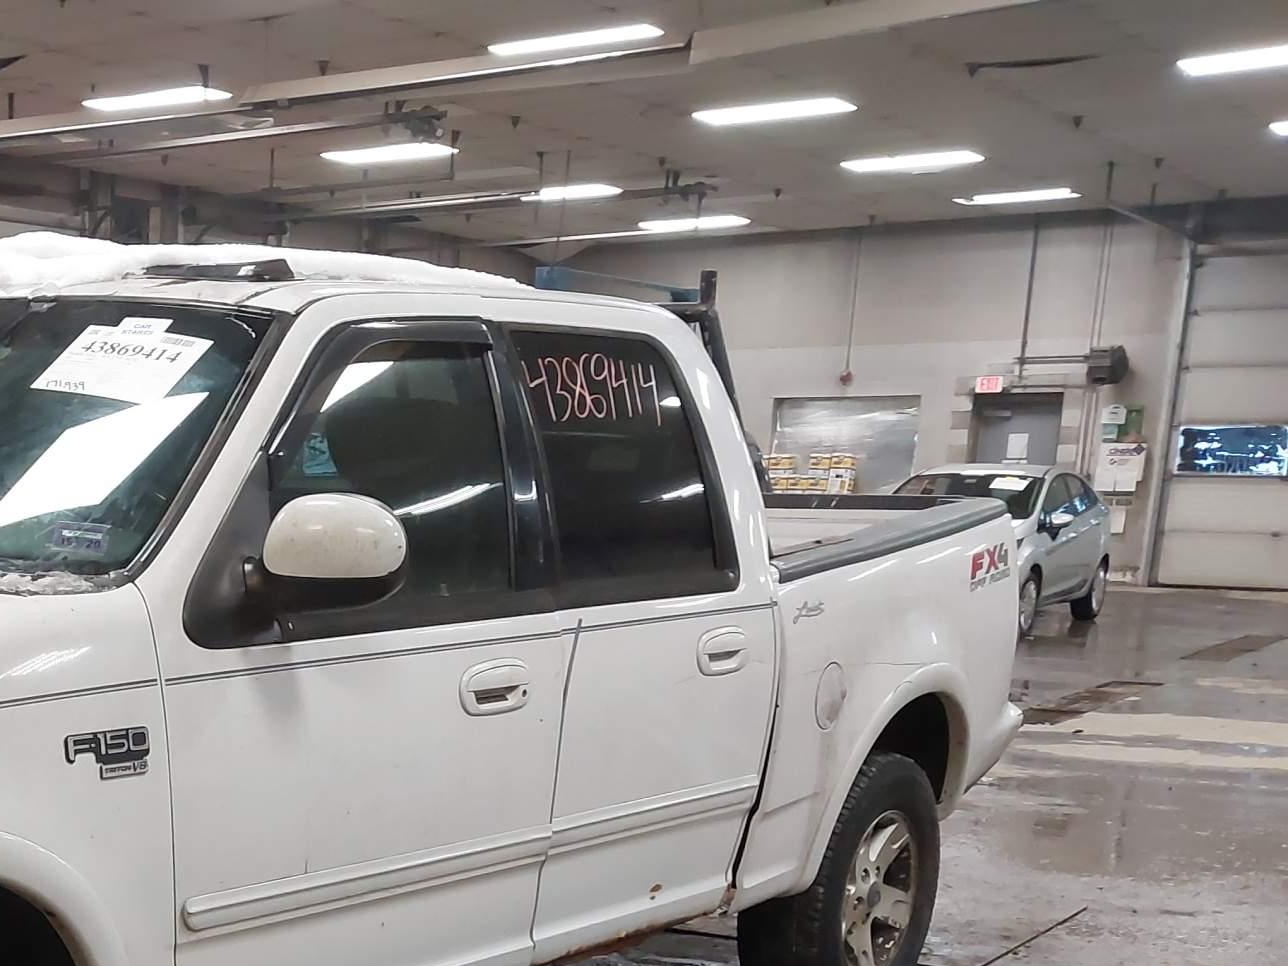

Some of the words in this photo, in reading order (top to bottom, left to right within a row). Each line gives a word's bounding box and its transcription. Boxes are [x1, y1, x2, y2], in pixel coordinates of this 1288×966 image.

[81, 340, 183, 364] 43869414
[521, 354, 660, 427] 43869414
[980, 377, 1000, 391] EXIT
[971, 542, 1008, 580] FX4
